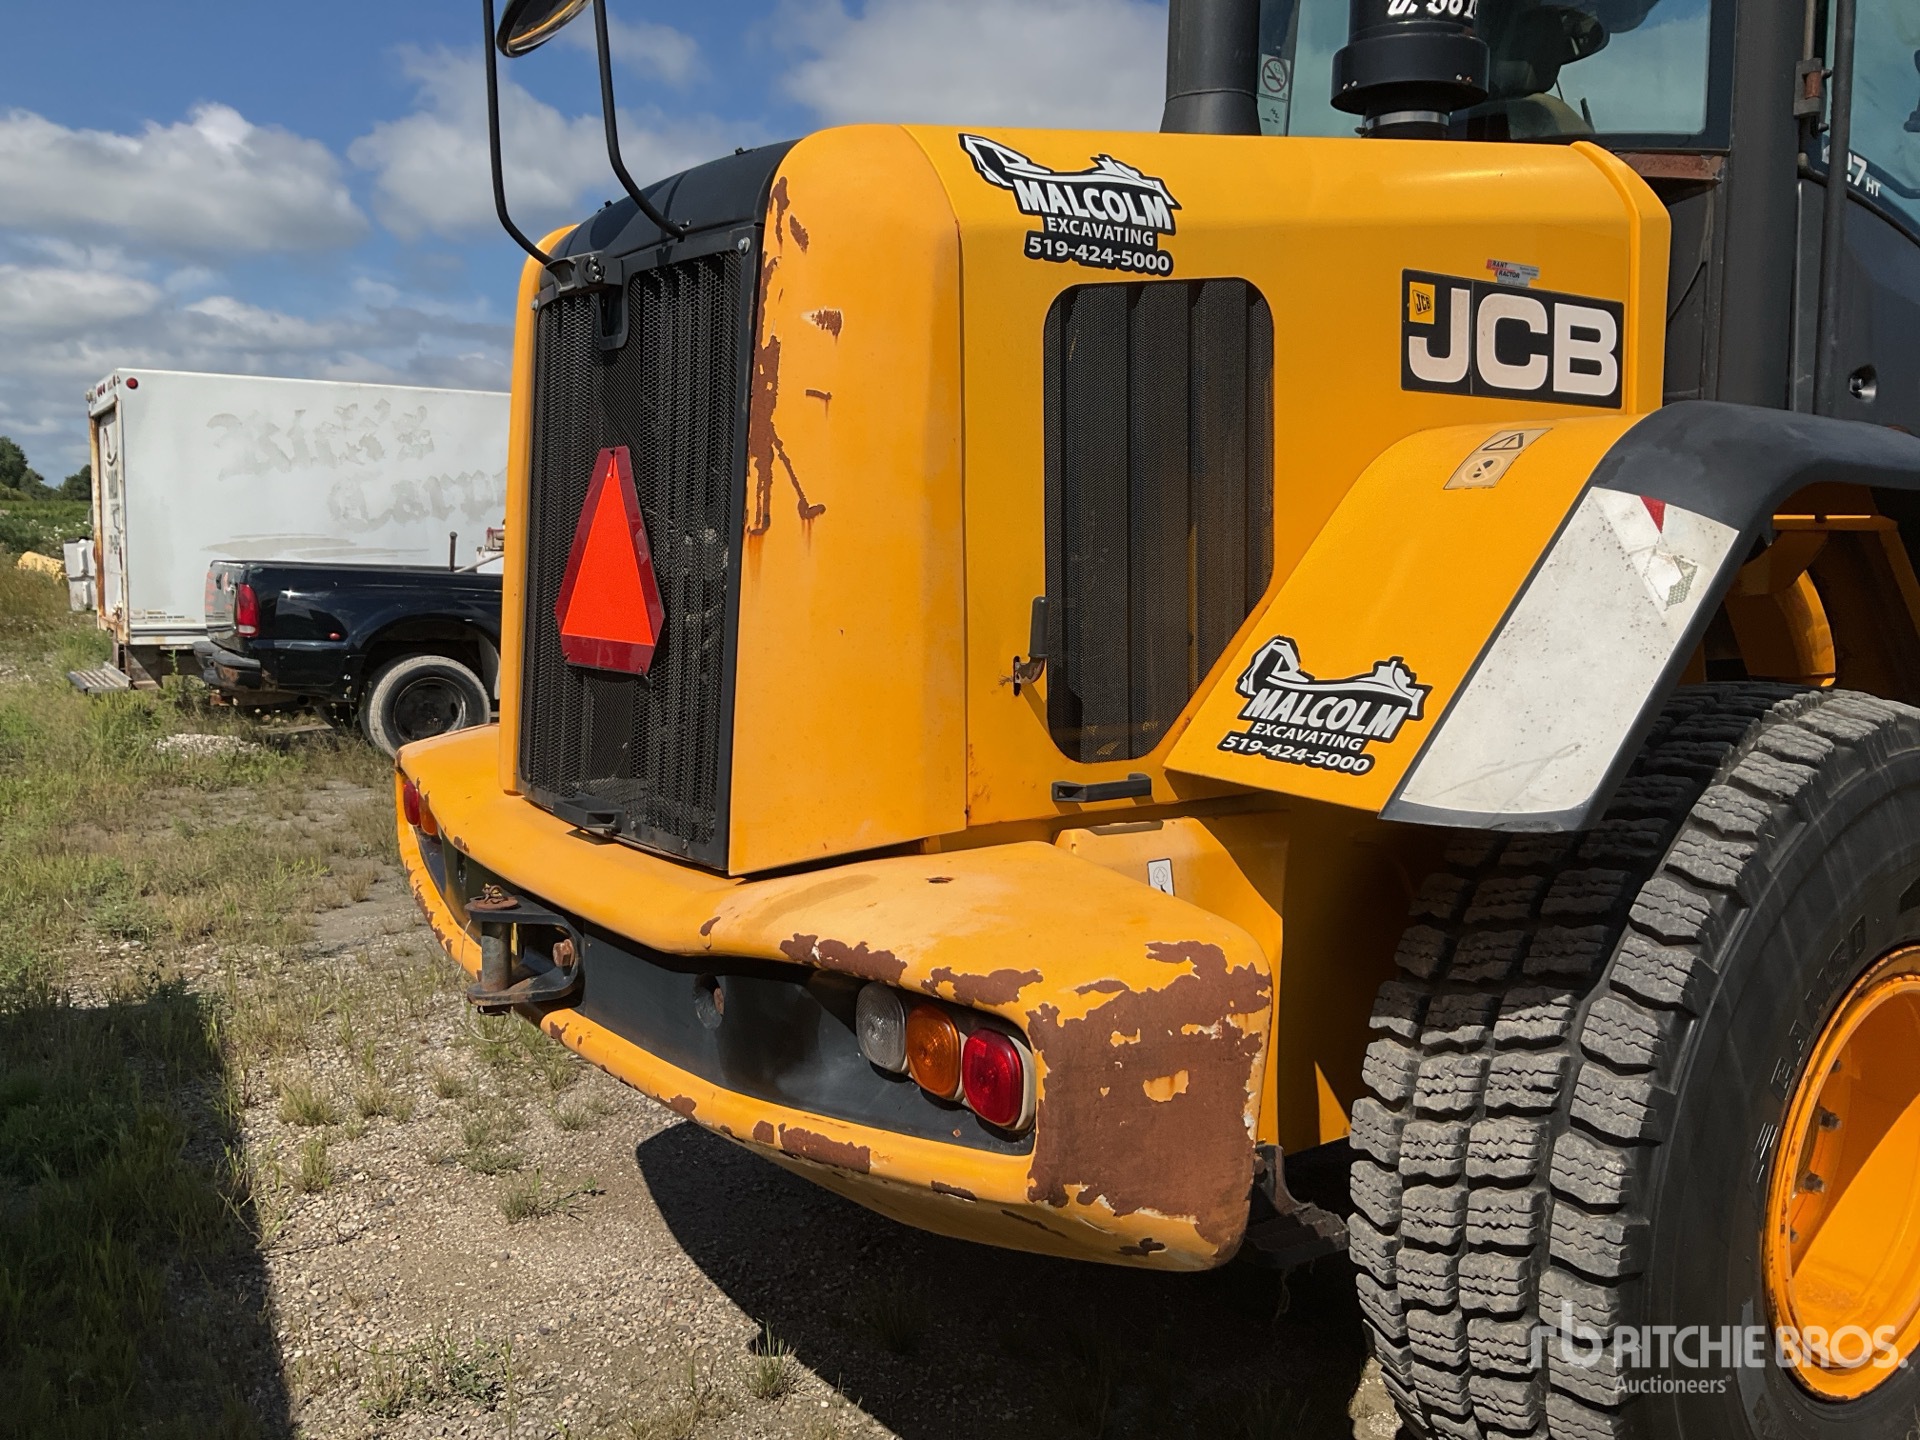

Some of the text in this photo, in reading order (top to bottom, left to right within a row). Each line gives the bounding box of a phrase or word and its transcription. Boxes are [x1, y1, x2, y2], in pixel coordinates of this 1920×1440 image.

[1013, 179, 1172, 230] MALCOLM
[1866, 176, 1882, 197] HT
[1047, 217, 1154, 246] EXCAVATING
[1028, 236, 1170, 272] 519-424-5000
[1415, 292, 1431, 312] JCB
[1408, 287, 1618, 396] JCB
[1243, 688, 1408, 739] MALCOLM
[1222, 735, 1370, 773] 519-424-5000
[1251, 722, 1365, 751] EXCAVATING
